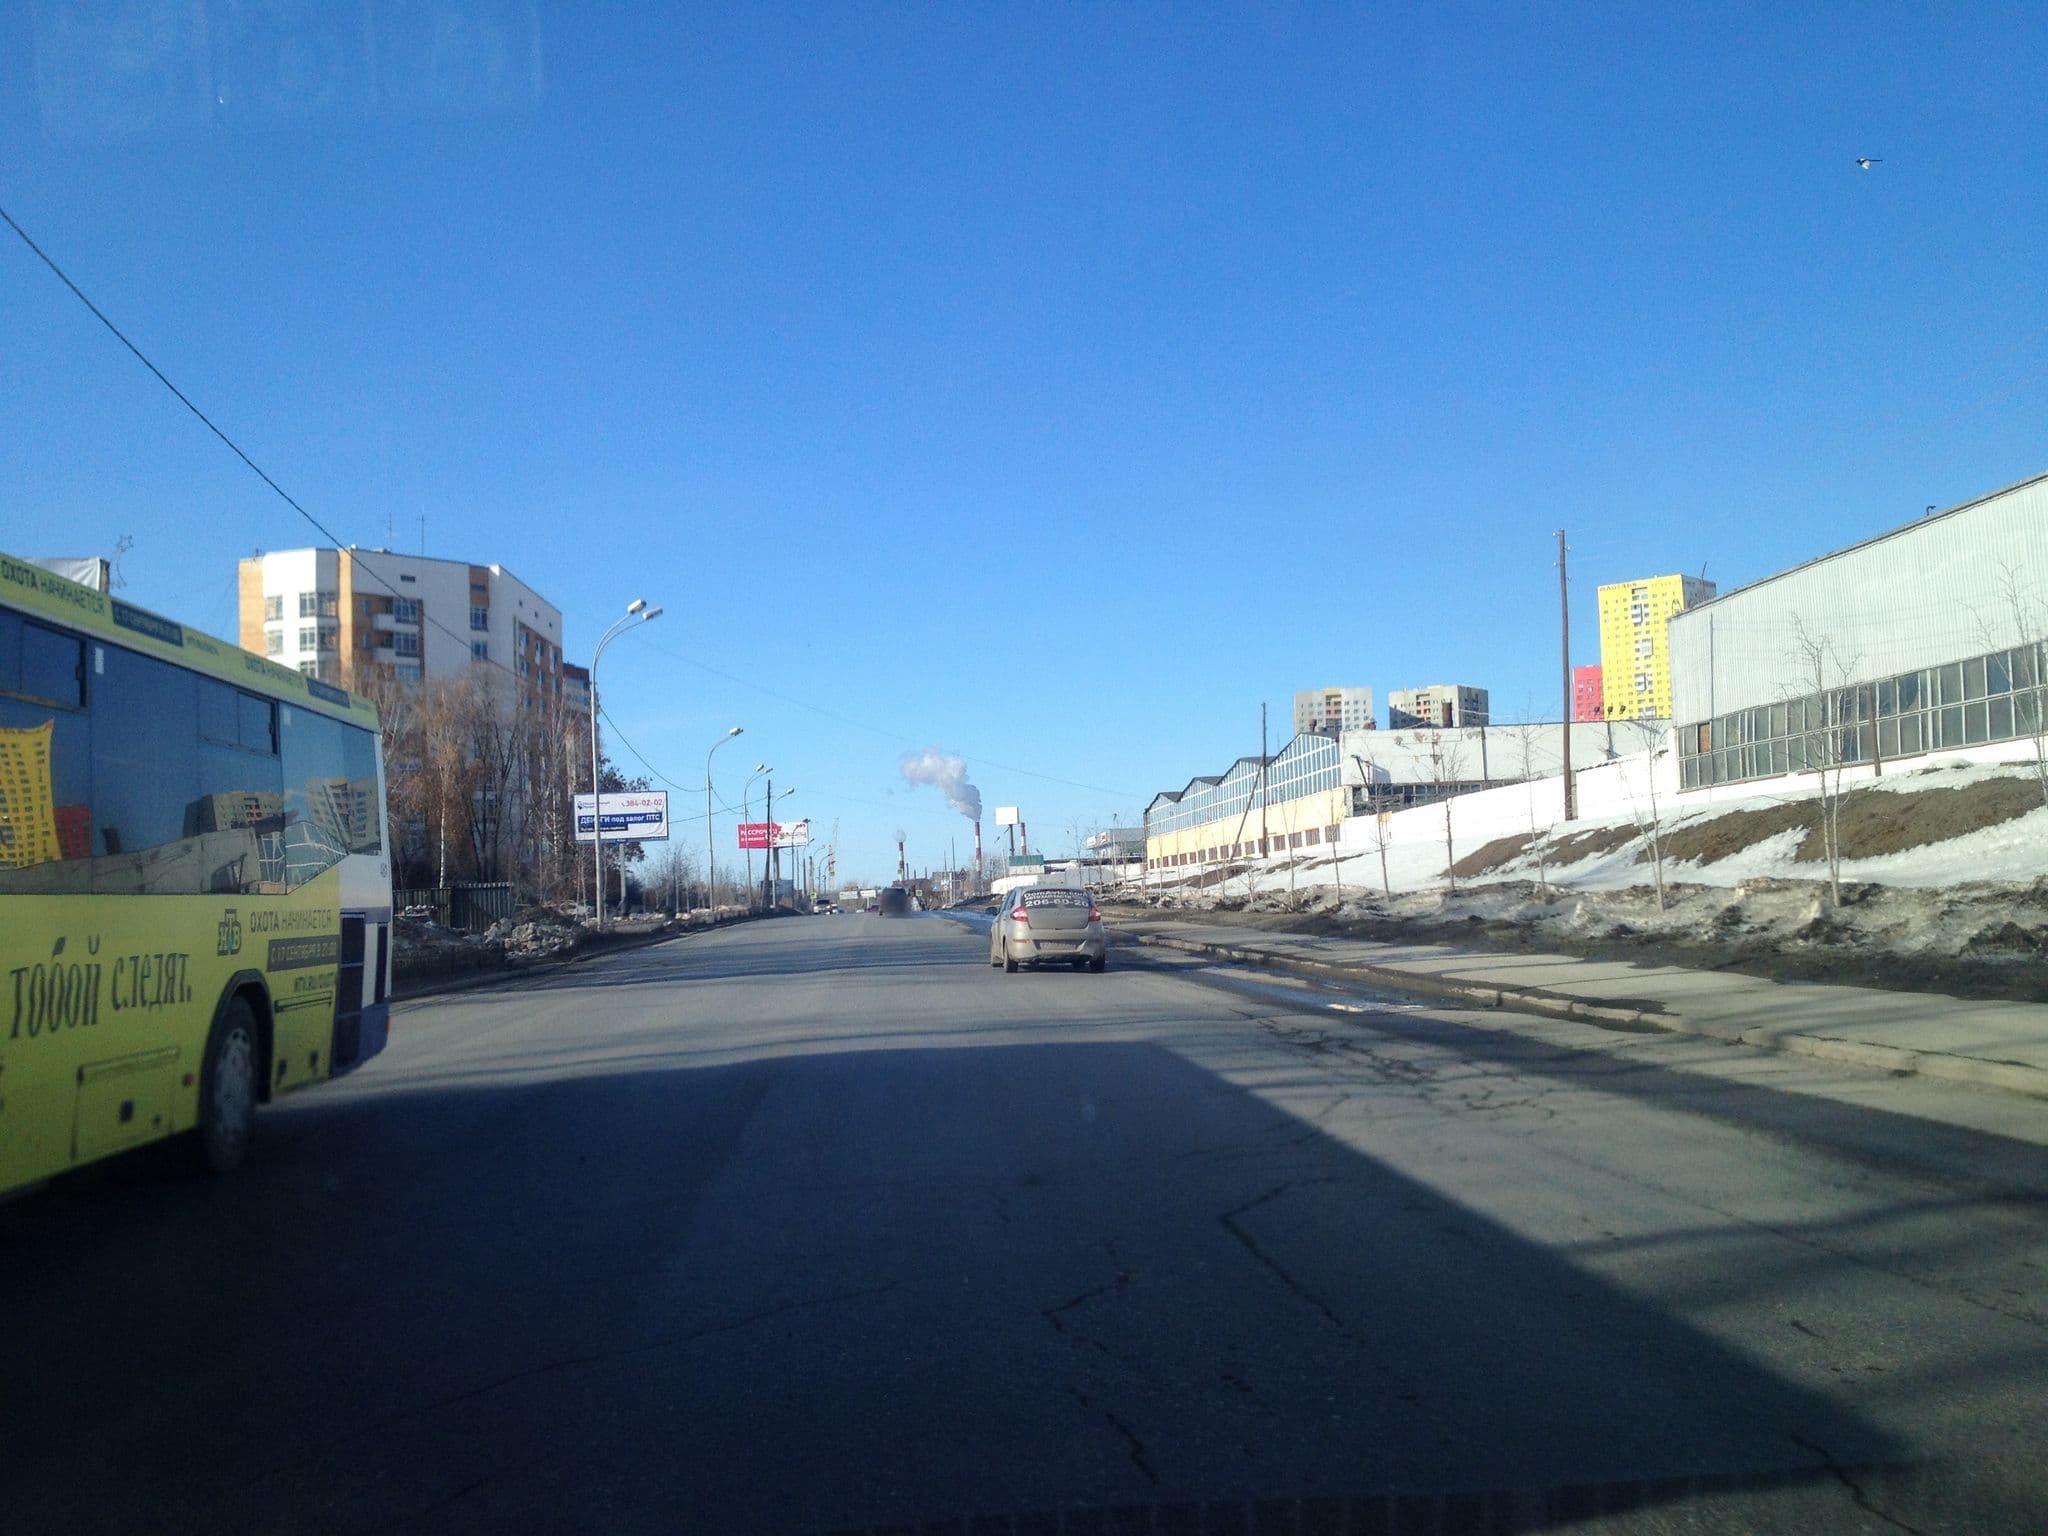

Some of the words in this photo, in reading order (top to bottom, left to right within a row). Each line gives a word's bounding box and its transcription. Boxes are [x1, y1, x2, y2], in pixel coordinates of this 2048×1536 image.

[580, 816, 610, 824] ДЕНГИ
[250, 910, 280, 933] ОХОТА
[281, 909, 332, 930] НАЧИНАЕТСЯ
[111, 952, 192, 1012] следят.
